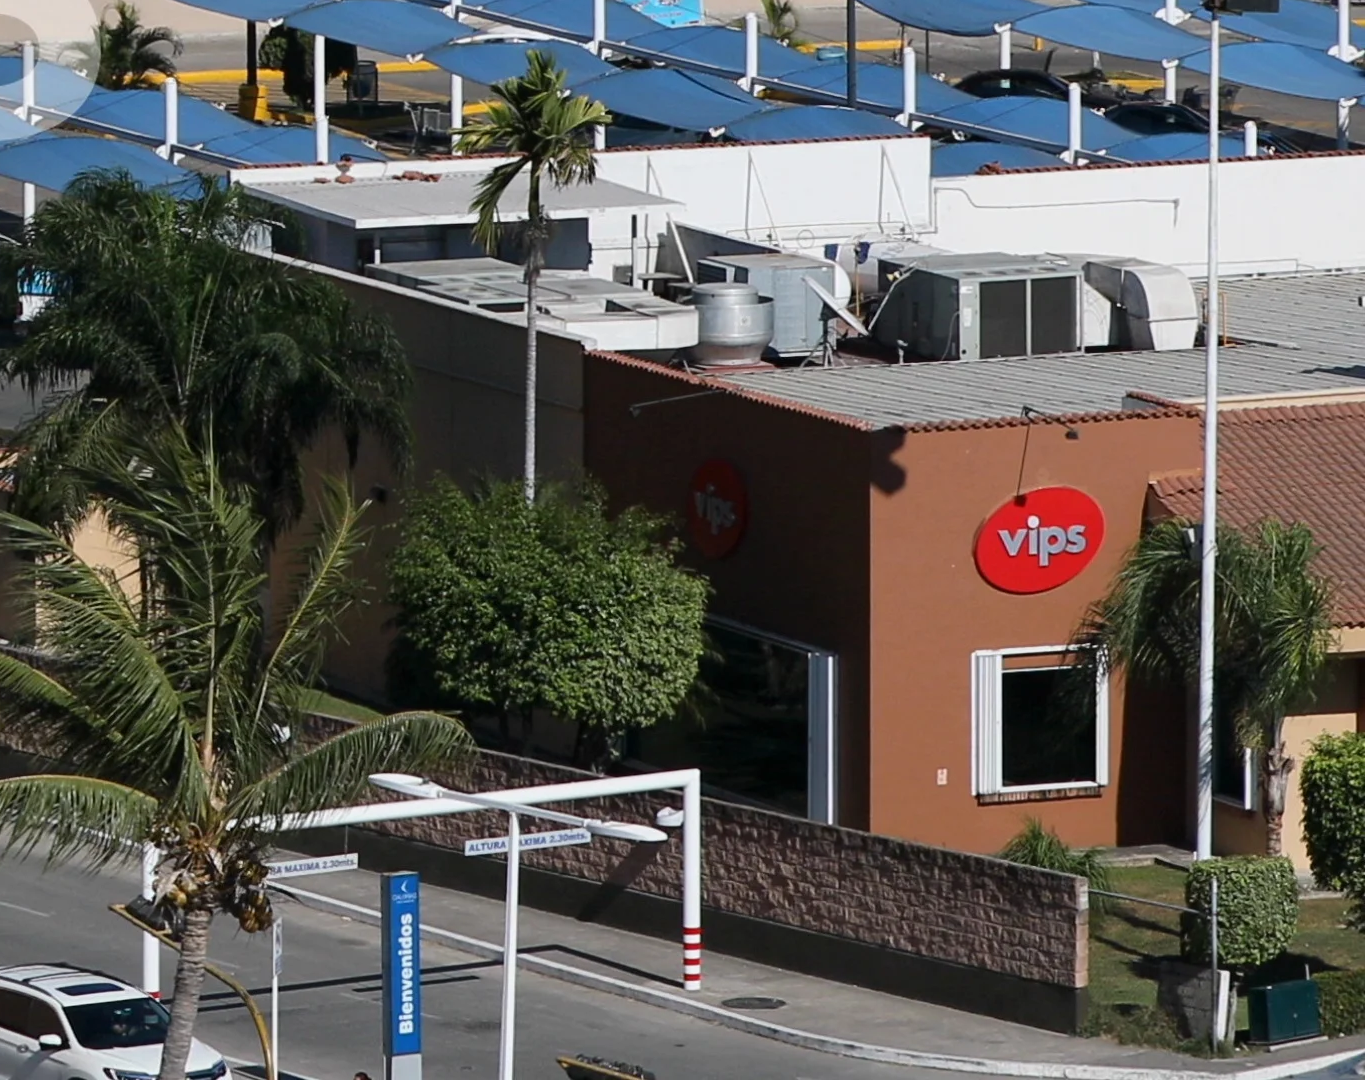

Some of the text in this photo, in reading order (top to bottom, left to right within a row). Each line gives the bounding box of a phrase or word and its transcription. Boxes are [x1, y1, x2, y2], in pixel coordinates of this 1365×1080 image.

[694, 482, 736, 536] vips
[998, 515, 1087, 567] vips
[284, 862, 320, 873] MAXIMA
[469, 840, 506, 852] ALTURA
[399, 913, 414, 1035] Bienvenidos
